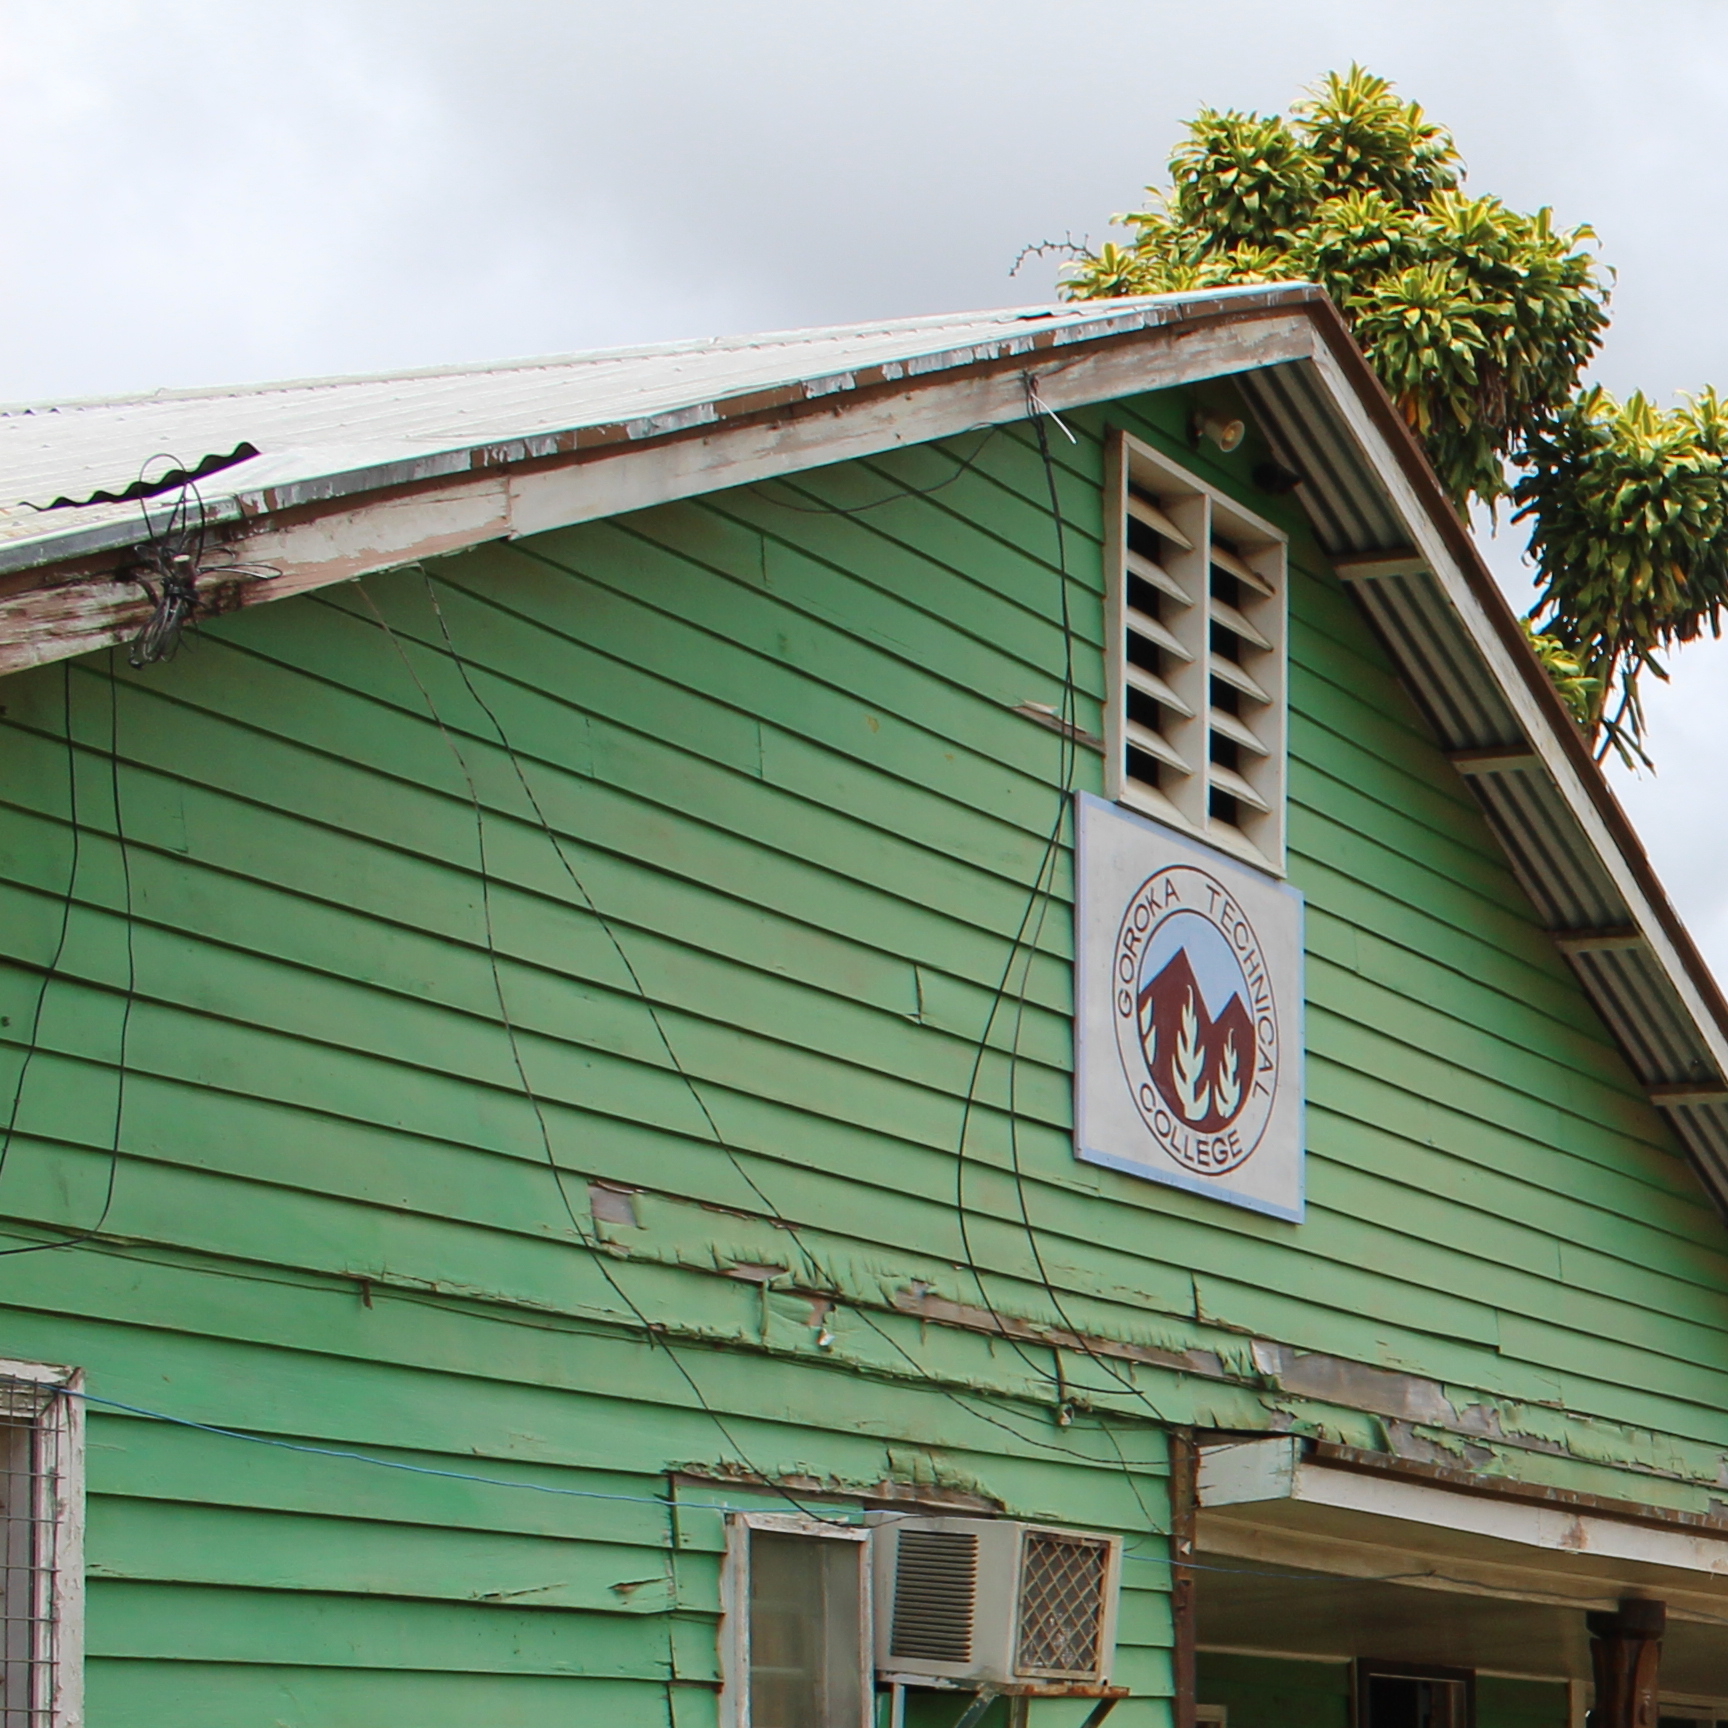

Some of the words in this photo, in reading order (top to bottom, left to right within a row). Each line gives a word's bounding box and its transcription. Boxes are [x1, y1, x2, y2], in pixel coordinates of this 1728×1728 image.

[1118, 877, 1181, 1018] GOROKA
[1205, 883, 1275, 1098] TECHNICAL
[1140, 1083, 1243, 1167] COLLEGE
